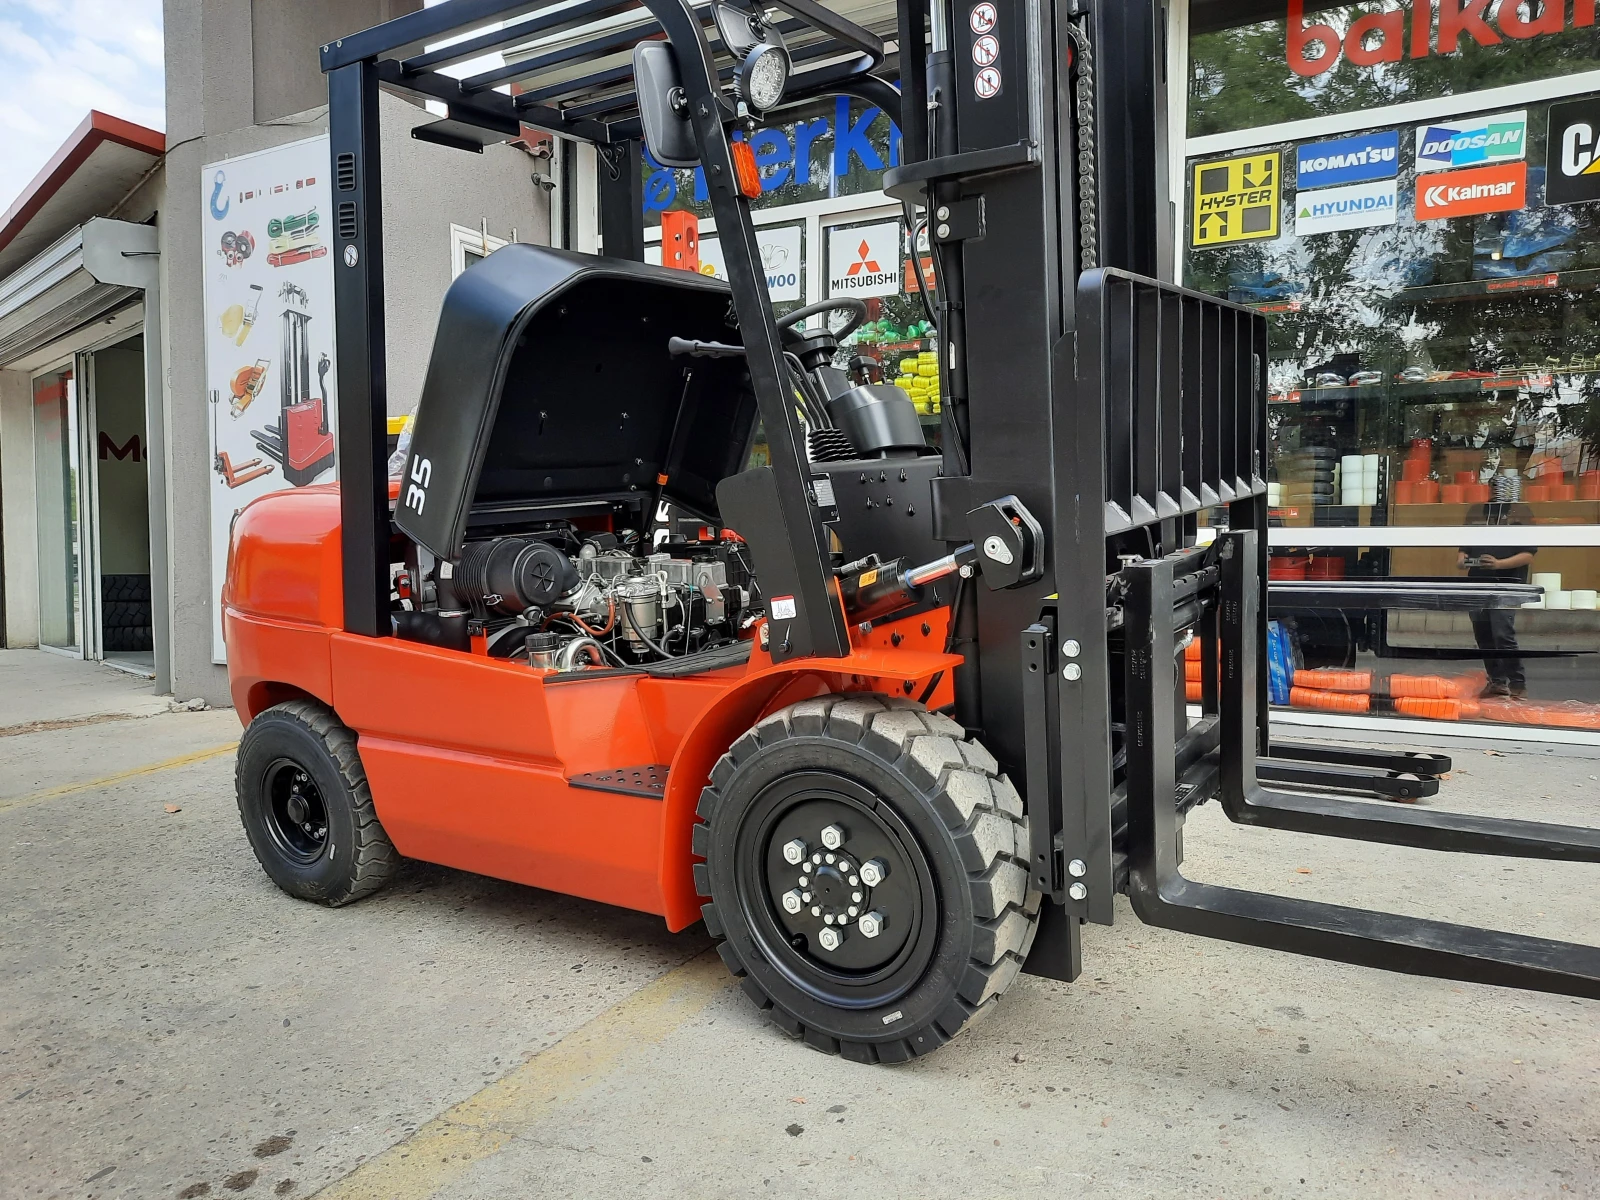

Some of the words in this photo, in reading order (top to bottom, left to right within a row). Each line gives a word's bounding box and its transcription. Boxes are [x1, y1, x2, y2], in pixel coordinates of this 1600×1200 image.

[1286, 0, 1595, 76] balka
[1422, 129, 1522, 156] DOOSAN
[1561, 123, 1600, 177] C
[1299, 146, 1396, 174] KOMATSU
[1200, 190, 1272, 211] HYSTER
[1447, 181, 1516, 202] Kalmar
[1312, 194, 1394, 216] HYUNDAI
[766, 273, 796, 289] WOO
[831, 272, 897, 290] MITSUBISHI
[405, 453, 432, 516] 35
